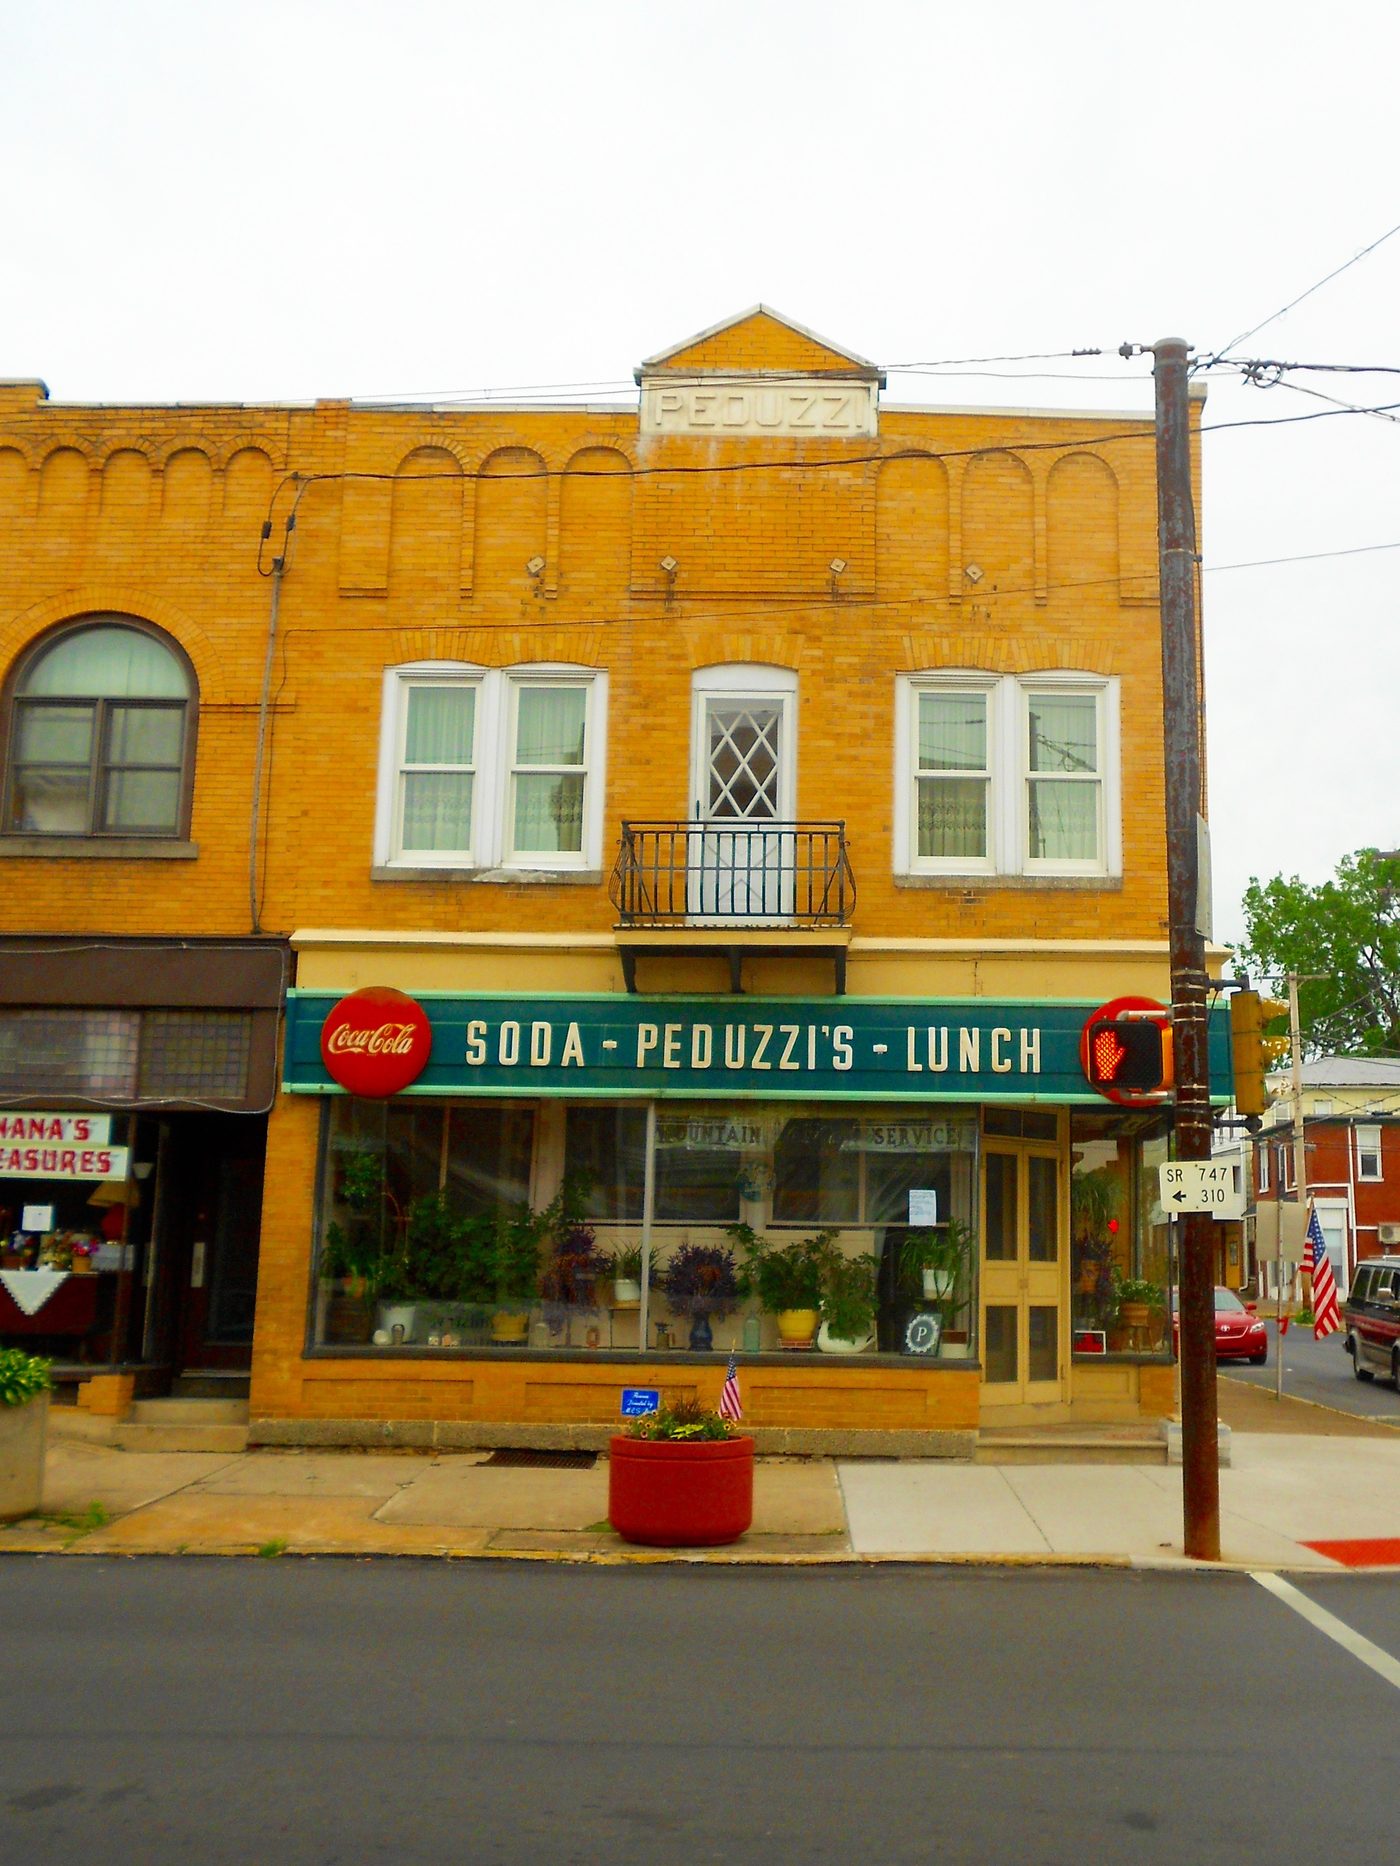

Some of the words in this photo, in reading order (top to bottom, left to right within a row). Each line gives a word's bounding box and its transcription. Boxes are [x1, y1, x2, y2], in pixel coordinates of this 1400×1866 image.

[655, 395, 863, 428] PEDUZZI
[327, 1023, 417, 1054] Coca-Cola
[465, 1020, 585, 1067] SODA
[636, 1023, 854, 1071] PEDUZZI'S
[907, 1026, 1041, 1073] LUNCH
[872, 1126, 958, 1145] SERVICE
[0, 1148, 112, 1174] ASURES
[1166, 1169, 1183, 1182] SR
[1199, 1168, 1227, 1181] 747
[1201, 1189, 1225, 1202] 310
[915, 1326, 928, 1342] P
